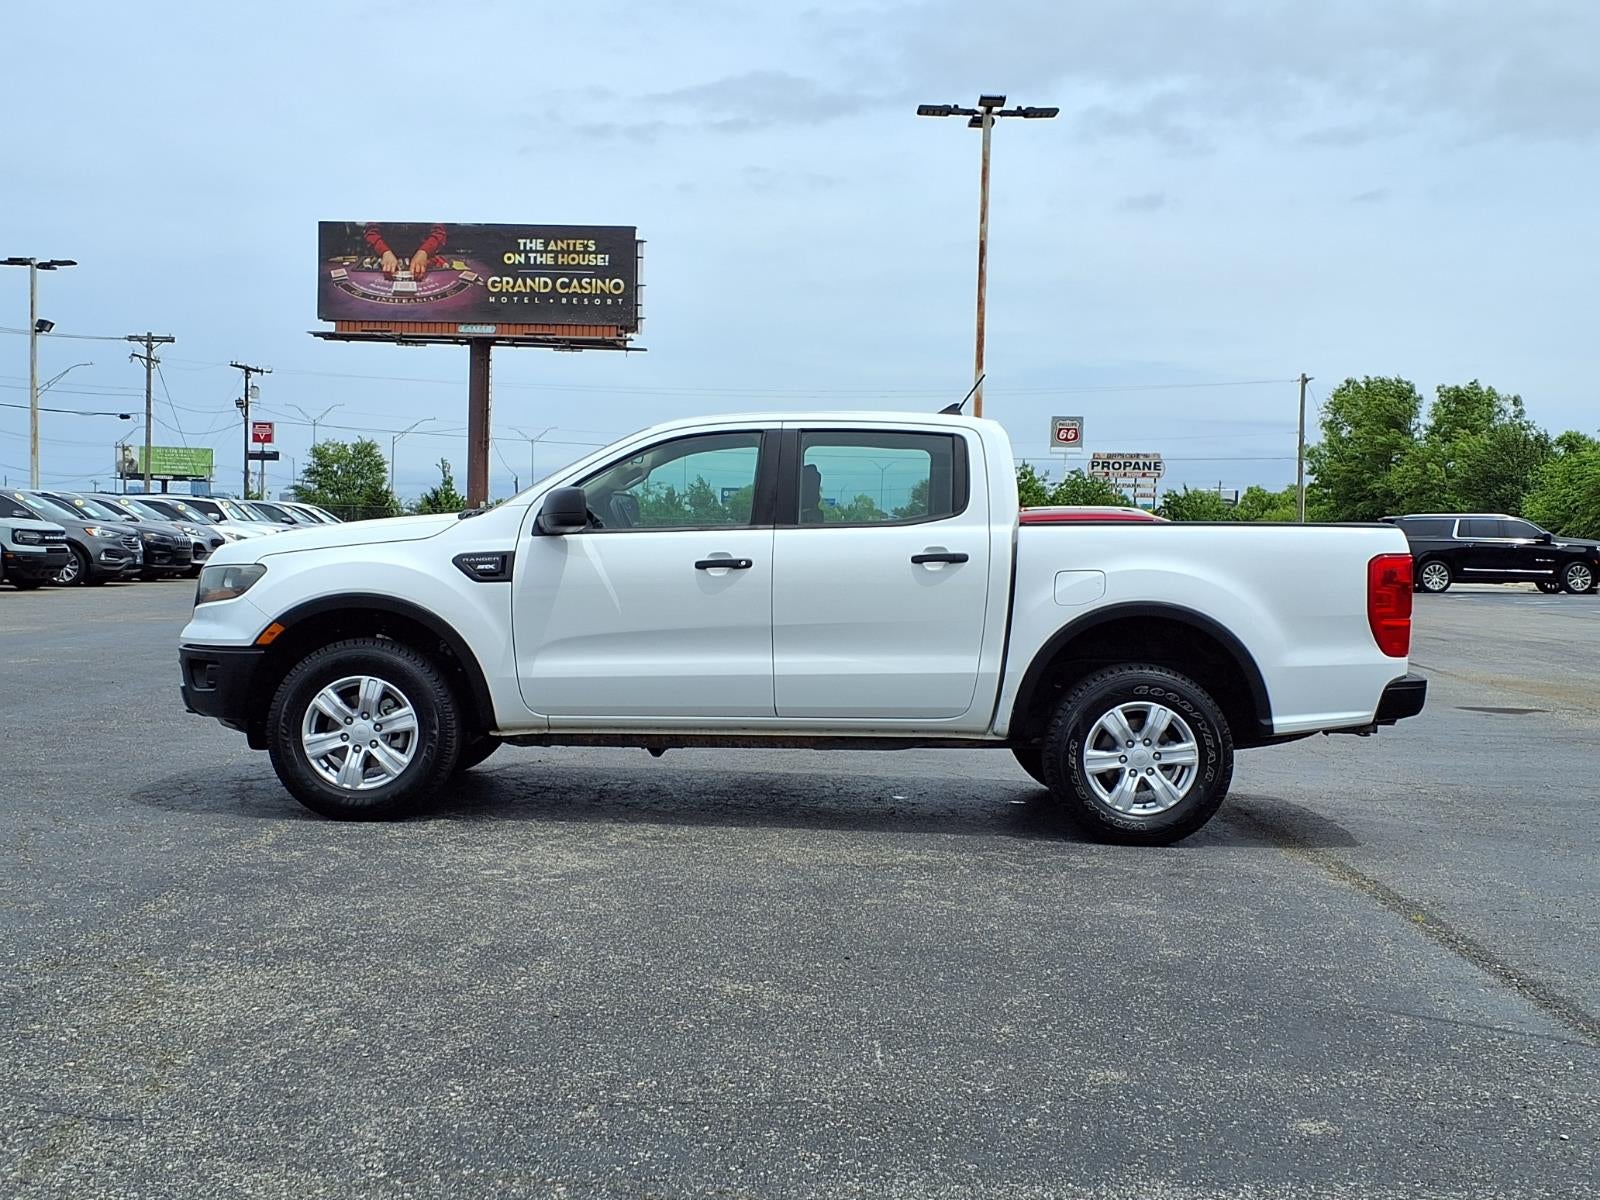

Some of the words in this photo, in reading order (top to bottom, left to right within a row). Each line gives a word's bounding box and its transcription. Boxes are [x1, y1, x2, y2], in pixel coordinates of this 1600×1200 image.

[518, 239, 544, 250] THE
[547, 239, 596, 251] ANTE'S
[503, 252, 525, 264] ON
[528, 253, 555, 265] THE
[557, 253, 609, 266] HOUSE!
[487, 276, 553, 293] GRAND
[556, 277, 625, 294] CASINO
[489, 296, 540, 304] HOTEL
[1058, 429, 1075, 439] 66
[1090, 461, 1162, 471] PROPANE
[1132, 685, 1217, 782] GOODYEAR
